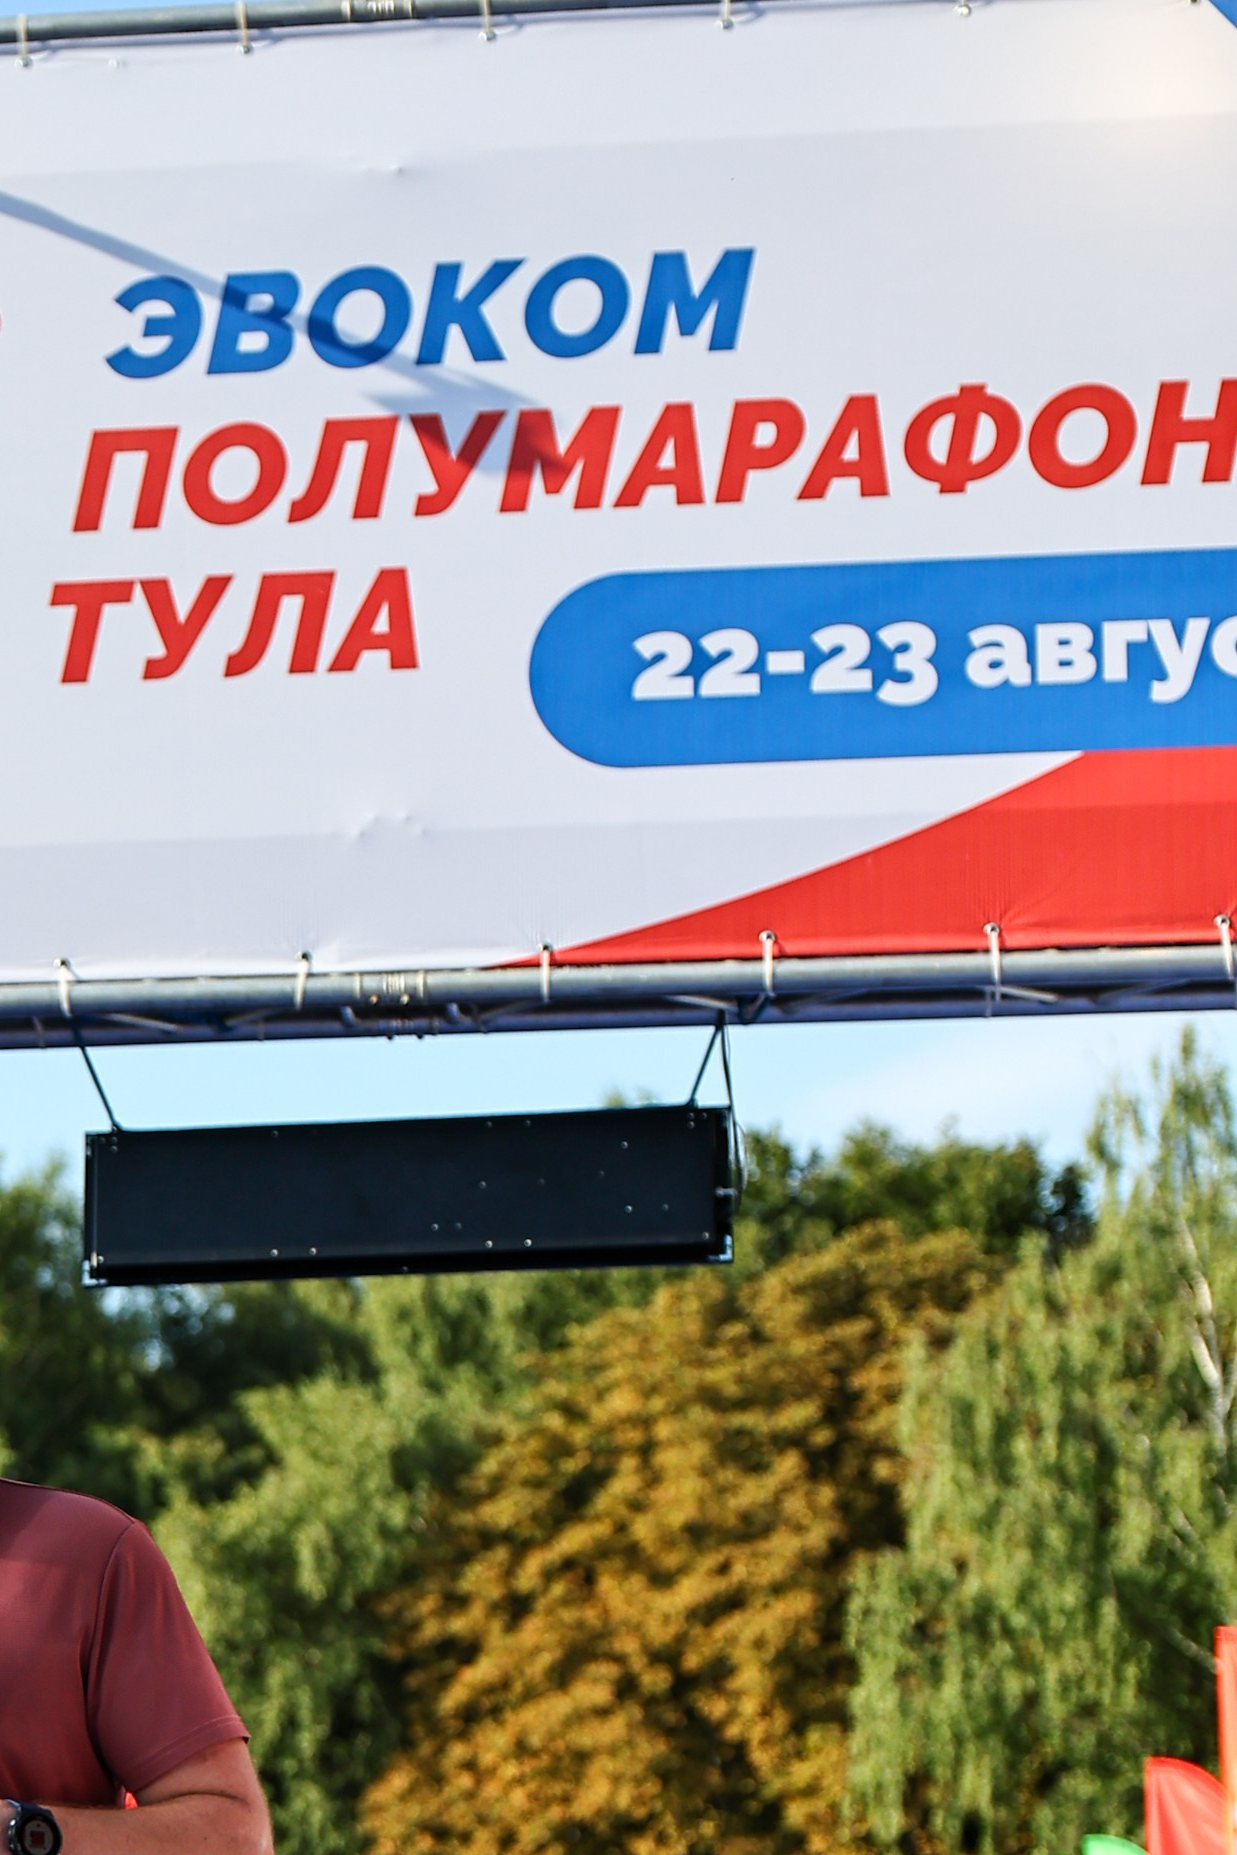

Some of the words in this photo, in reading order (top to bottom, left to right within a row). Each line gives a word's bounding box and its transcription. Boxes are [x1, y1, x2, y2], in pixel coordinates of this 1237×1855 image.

[105, 246, 756, 379] ЭВОКОМ
[71, 378, 1237, 533] ПОЛУМАРАФОН
[48, 567, 420, 685] ТУЛА
[632, 618, 939, 707] 22-23
